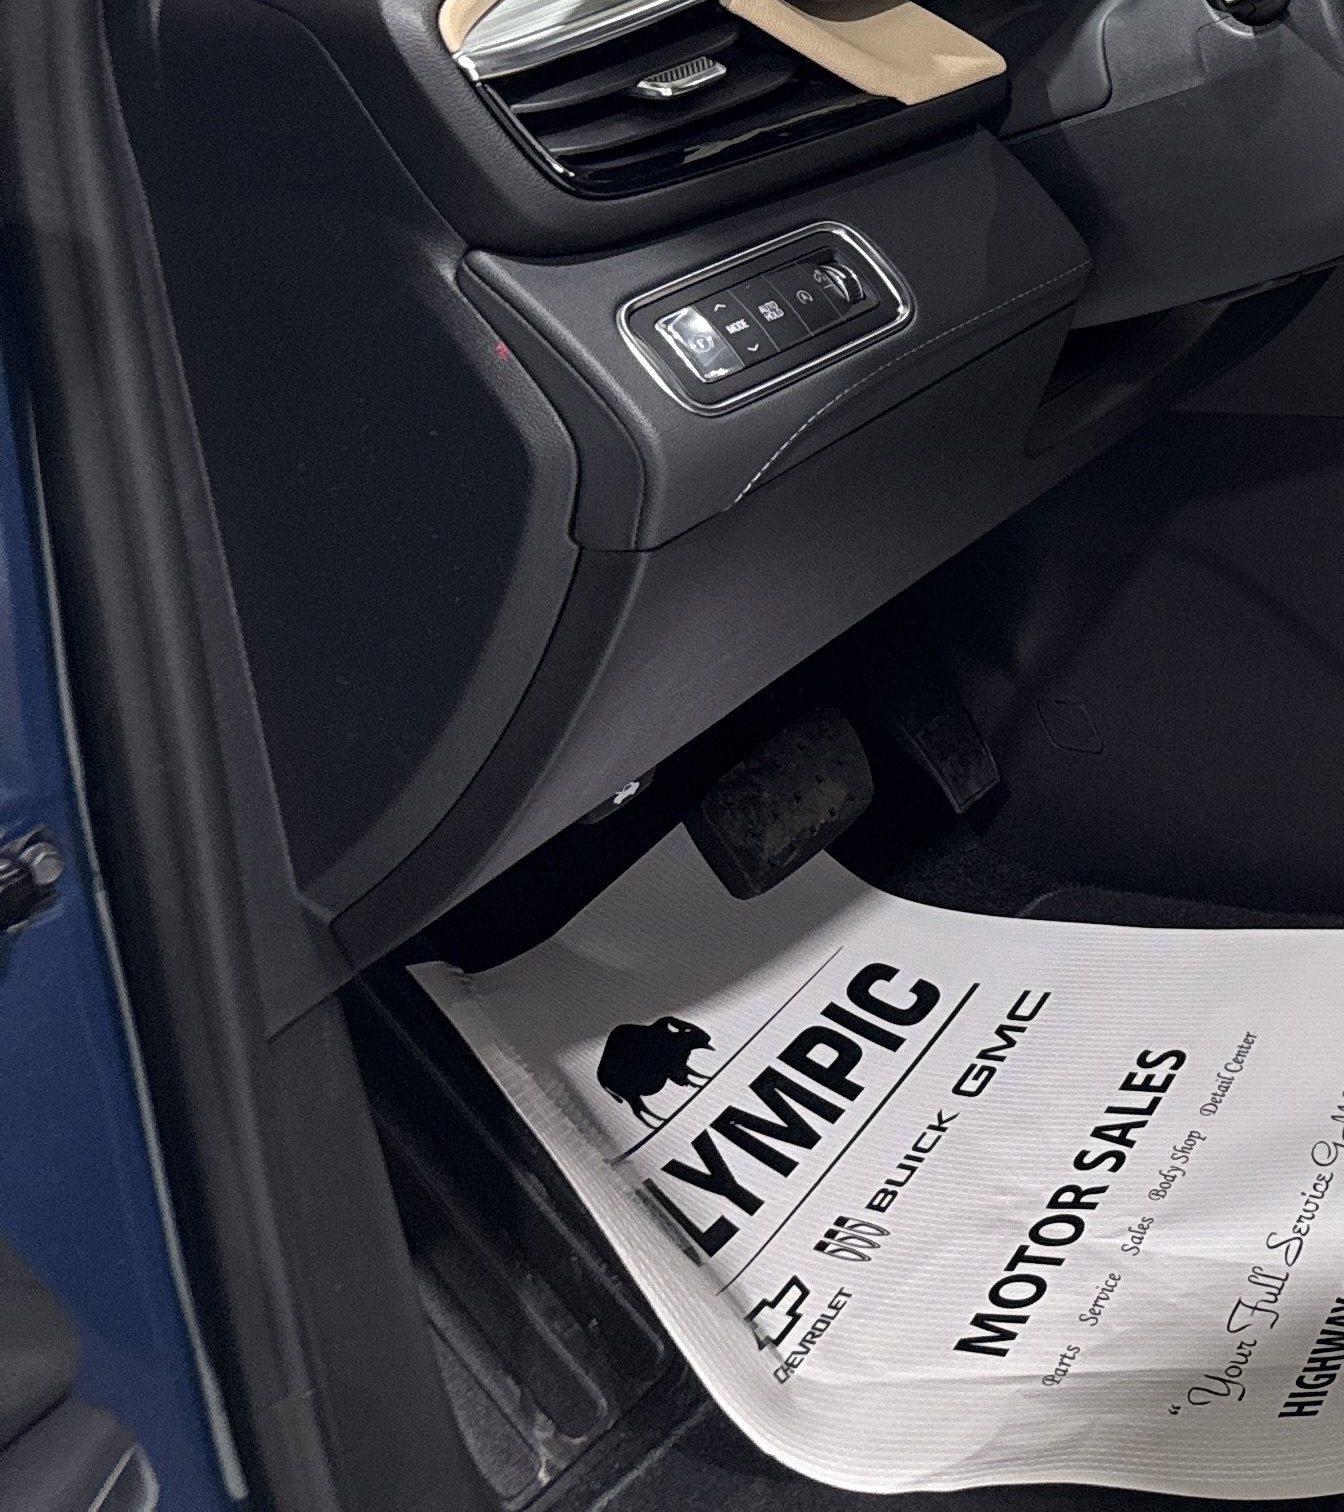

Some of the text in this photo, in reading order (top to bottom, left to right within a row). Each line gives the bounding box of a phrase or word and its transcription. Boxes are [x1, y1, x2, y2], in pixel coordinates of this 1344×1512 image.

[725, 318, 750, 334] MODE
[758, 300, 779, 315] AUTO
[763, 308, 785, 322] HOLD
[951, 990, 1053, 1098] GMC
[635, 962, 941, 1267] LYMPIC
[865, 1108, 961, 1214] BUICK
[952, 1048, 1187, 1358] MOTOR SALES
[1041, 1031, 1259, 1388] Parts Service Sales Body Shop Detail Center
[1226, 1265, 1290, 1333] Full
[1266, 1172, 1334, 1267] Service
